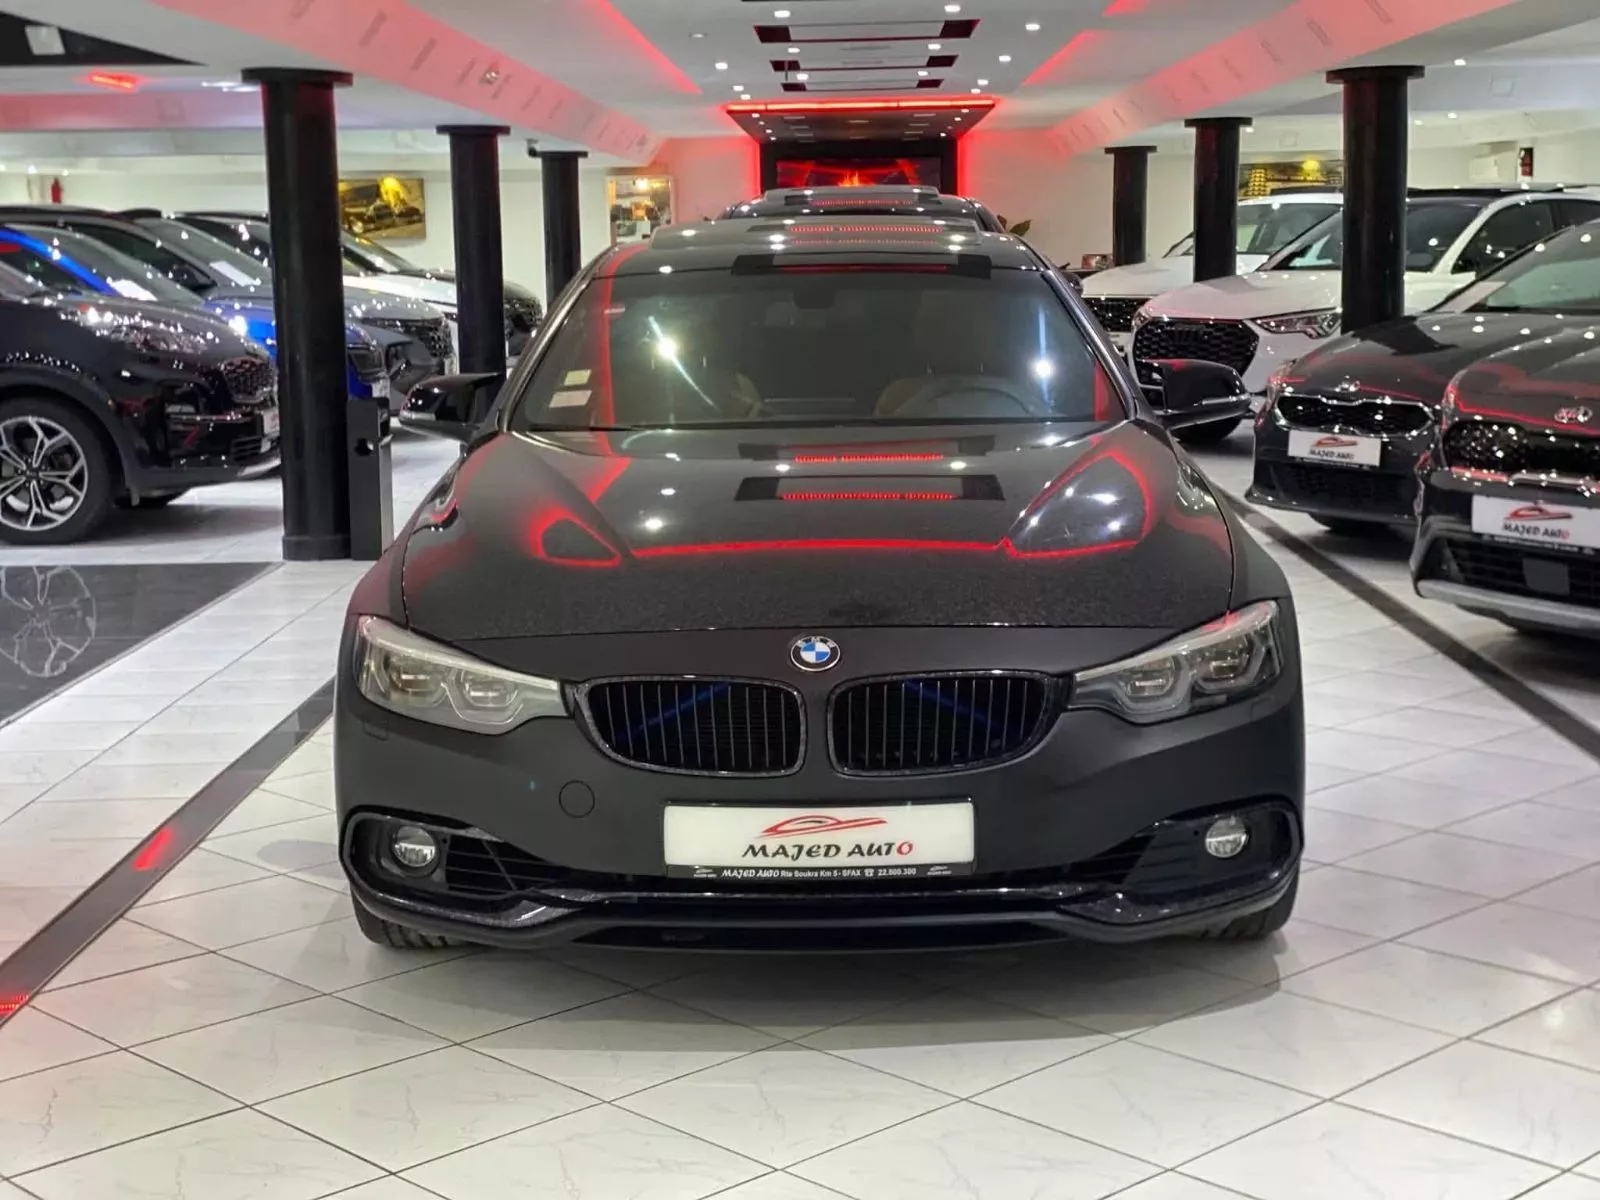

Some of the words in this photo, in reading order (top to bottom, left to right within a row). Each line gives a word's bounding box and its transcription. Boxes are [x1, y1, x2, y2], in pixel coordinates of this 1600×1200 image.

[1503, 522, 1541, 535] MAJED
[742, 843, 842, 862] MAJED
[847, 841, 914, 858] AUTO
[721, 869, 756, 879] MAJED
[820, 869, 832, 877] Km
[842, 869, 861, 877] SFAX
